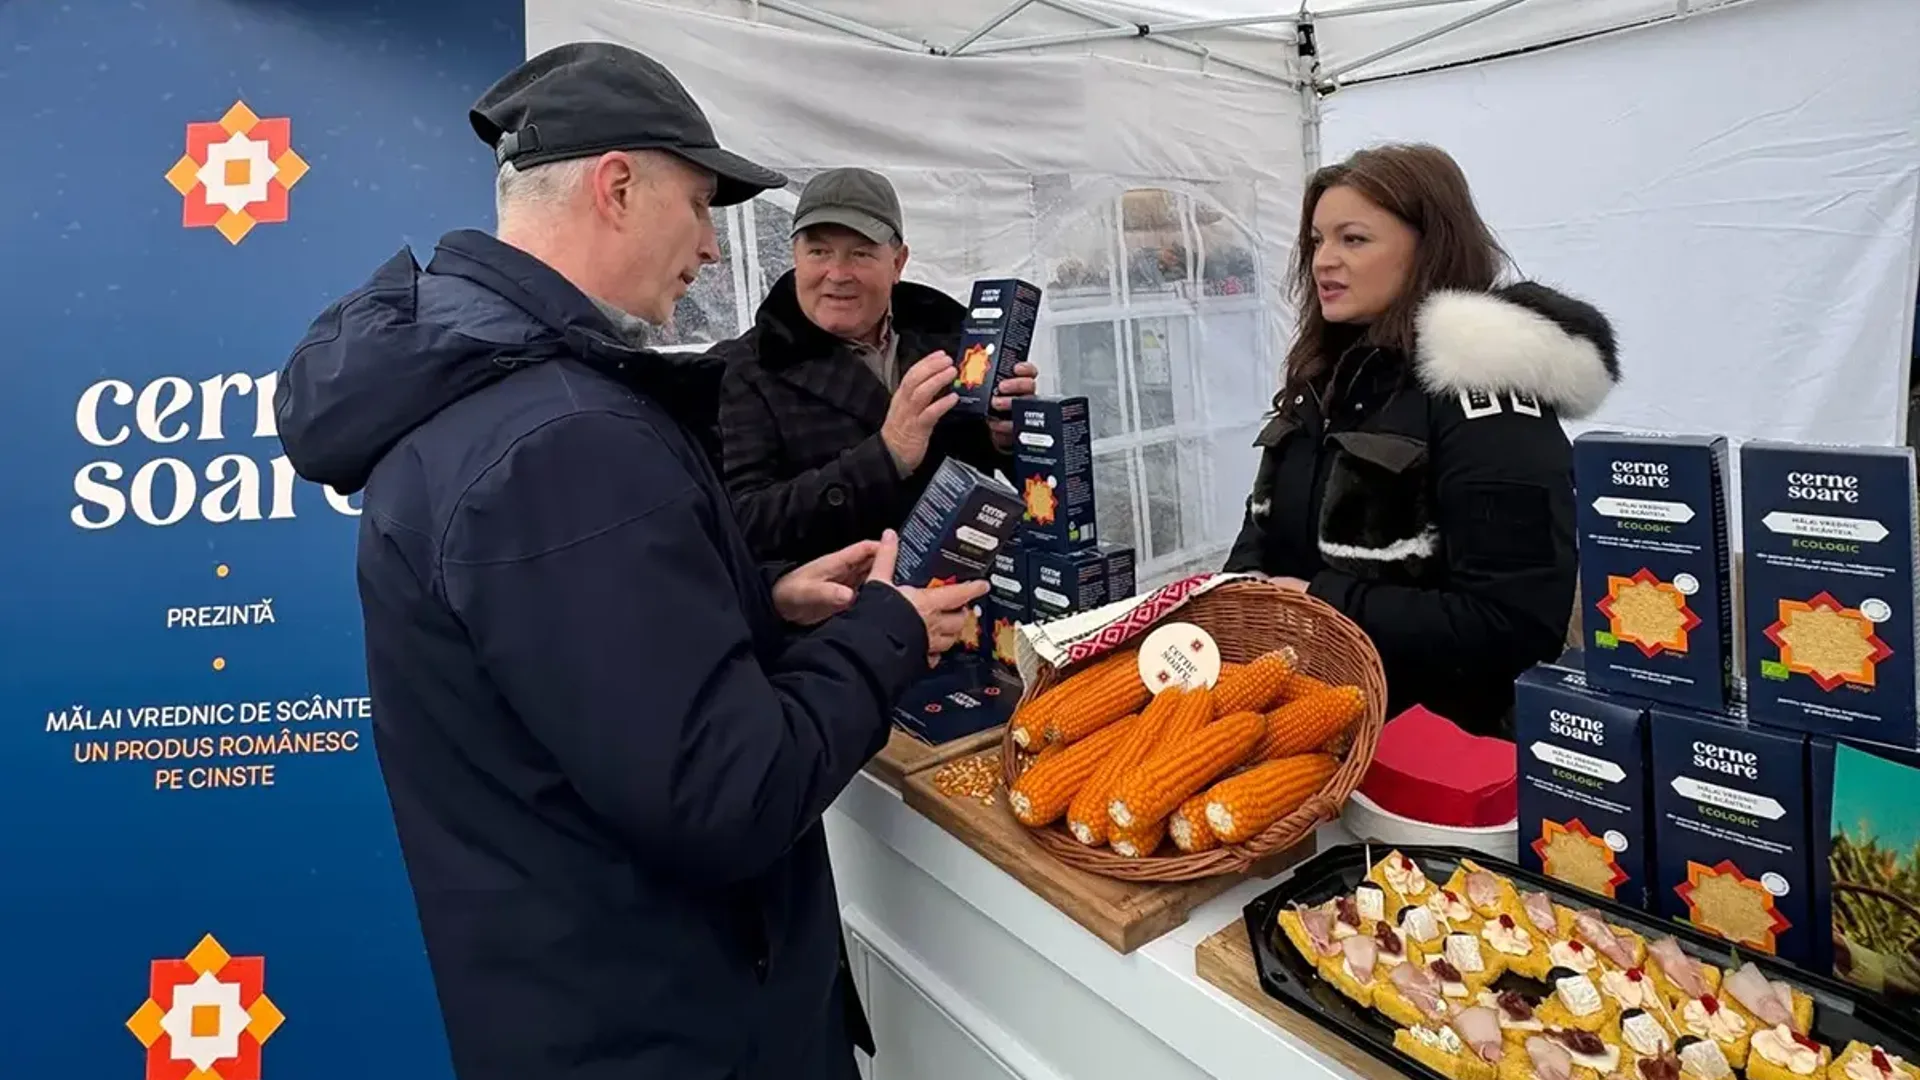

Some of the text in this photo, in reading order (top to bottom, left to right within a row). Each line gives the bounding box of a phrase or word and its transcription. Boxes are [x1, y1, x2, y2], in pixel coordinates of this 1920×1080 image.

[75, 370, 279, 446] cer
[1611, 460, 1669, 476] cerne
[1787, 471, 1859, 490] cerne
[1612, 473, 1670, 489] soare
[1787, 485, 1859, 503] soare
[1617, 521, 1671, 533] ECOLOGIC
[1791, 539, 1860, 554] ECOLOGIC
[166, 598, 275, 628] PREZINTĂ
[1160, 650, 1191, 680] soare
[1168, 644, 1198, 673] cerne
[45, 694, 372, 732] MĂLAI VREDNIC DE SCÂNTE
[1549, 709, 1604, 733] cerne
[74, 728, 360, 763] UN PRODUS ROMÂNESC
[1549, 721, 1604, 746] soare
[1692, 741, 1758, 766] cerne
[155, 765, 275, 790] PE CINSTE
[1552, 767, 1604, 790] ECOLOGIC
[1692, 754, 1758, 780] soare
[1698, 805, 1759, 828] ECOLOGIC
